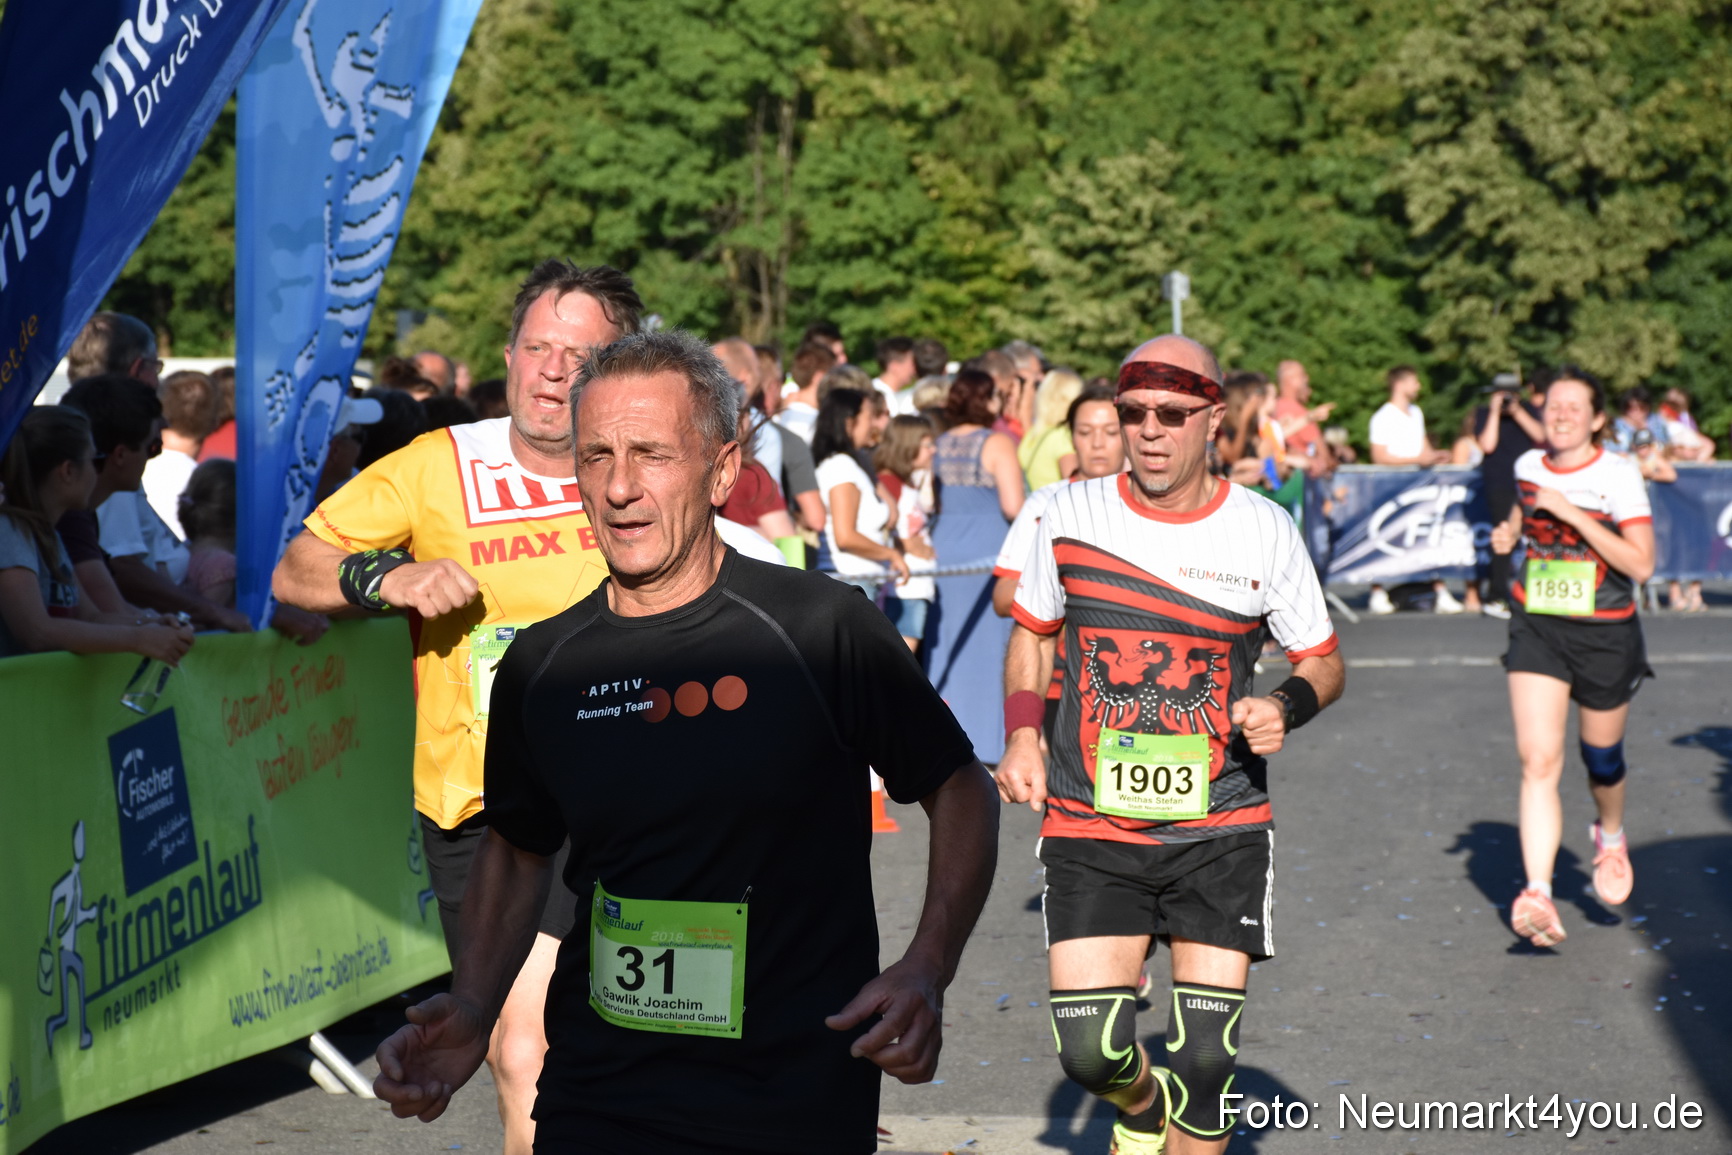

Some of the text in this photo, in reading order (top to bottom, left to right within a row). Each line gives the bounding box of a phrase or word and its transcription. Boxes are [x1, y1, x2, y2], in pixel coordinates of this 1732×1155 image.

[133, 14, 202, 128] Druck
[1403, 511, 1494, 548] Fisc
[469, 526, 600, 567] MAX B
[1178, 566, 1249, 587] NEUMARKT
[1536, 580, 1583, 599] 1893
[487, 639, 512, 648] firme
[589, 677, 642, 697] APTIV
[576, 700, 654, 720] Running Team
[128, 766, 175, 808] Fischer
[1110, 762, 1193, 796] 1903
[1118, 793, 1183, 806] Weithas Stefan
[1144, 804, 1173, 812] Neumarkt
[97, 813, 263, 988] firmenlauf
[650, 931, 684, 943] 2018
[615, 946, 675, 995] 31
[103, 959, 182, 1032] neumarkt
[602, 986, 641, 1007] Gawlik
[643, 996, 703, 1011] Joachim
[603, 1000, 635, 1016] Services
[637, 1008, 696, 1022] Deutschland
[697, 1013, 728, 1024] GmbH
